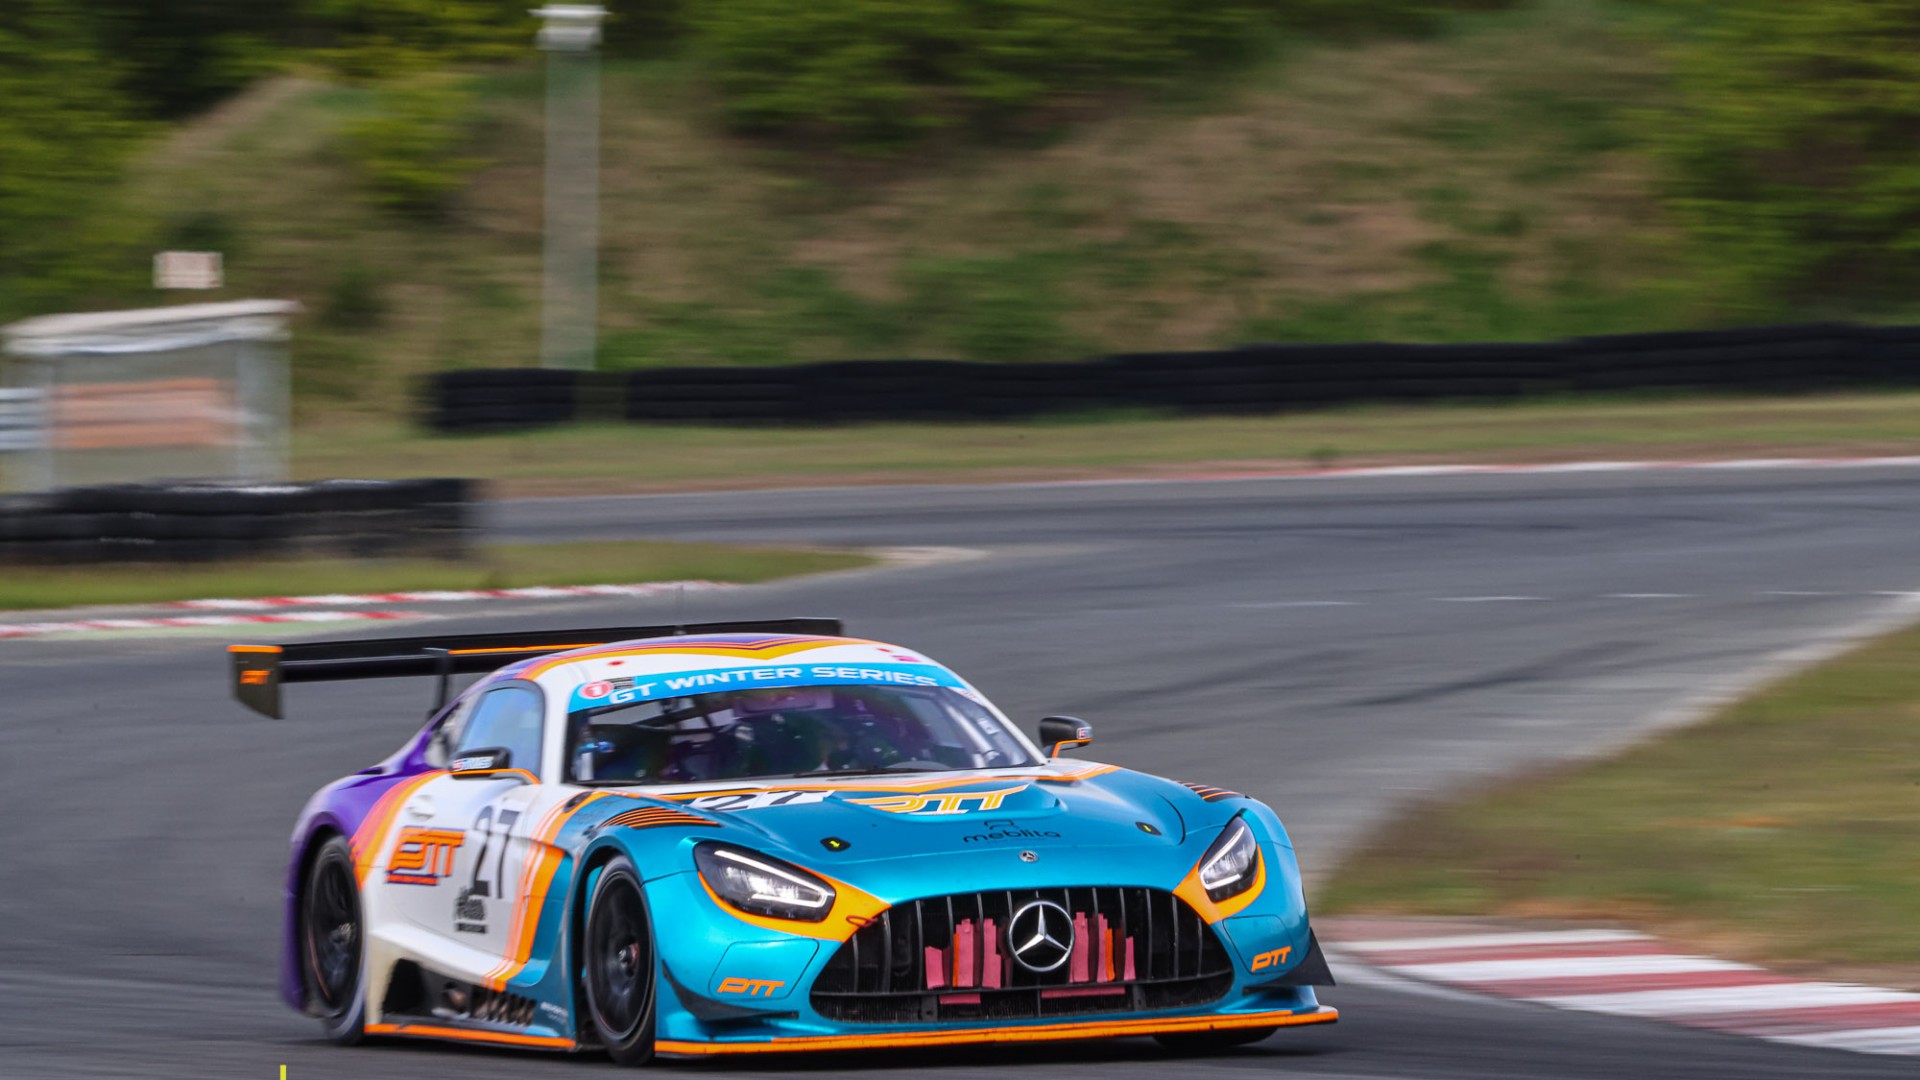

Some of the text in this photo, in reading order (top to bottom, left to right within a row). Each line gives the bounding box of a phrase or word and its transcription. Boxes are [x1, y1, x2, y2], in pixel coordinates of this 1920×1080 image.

[608, 683, 658, 705] GT
[665, 667, 802, 690] WINTER
[810, 666, 937, 687] SERIES
[704, 790, 804, 812] 27
[473, 806, 520, 899] 27
[1251, 946, 1292, 973] PTT
[717, 977, 785, 997] PTT
